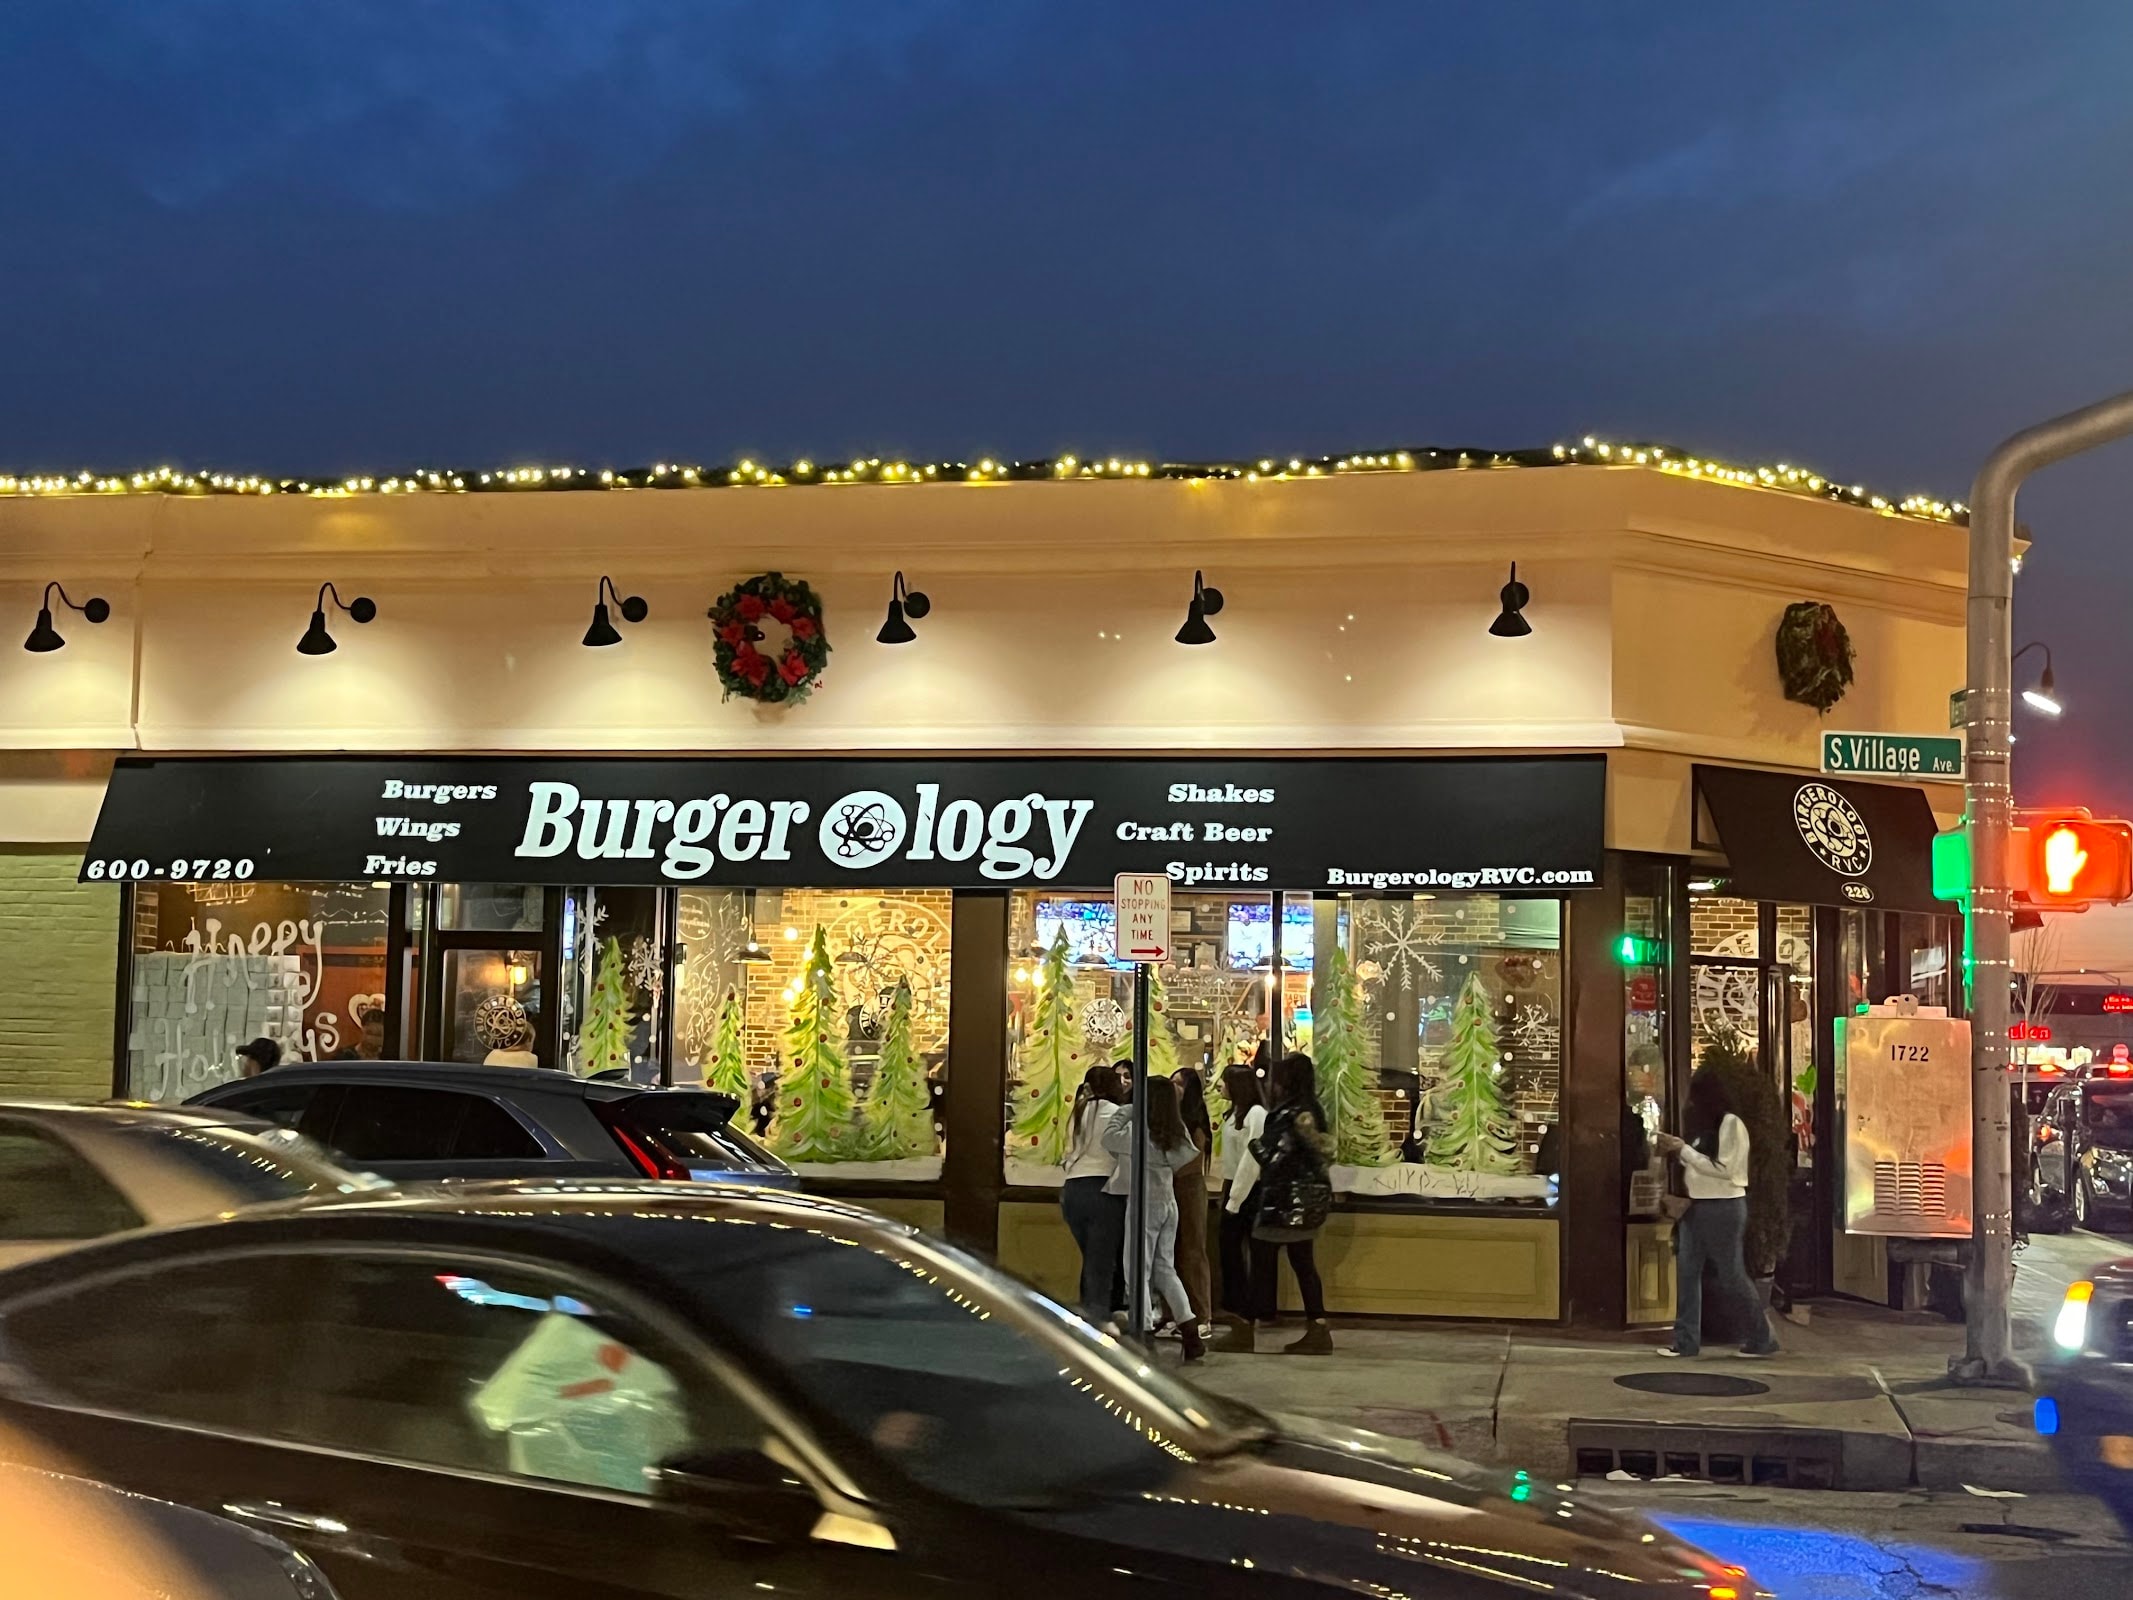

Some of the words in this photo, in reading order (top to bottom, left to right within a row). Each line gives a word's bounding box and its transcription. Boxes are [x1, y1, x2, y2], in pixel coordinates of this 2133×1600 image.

[382, 780, 498, 804] Burgers
[1168, 784, 1275, 803] Shakes
[1797, 787, 1869, 849] BURGEROLOGY
[376, 817, 461, 842] Wings
[1116, 821, 1195, 842] Craft
[1203, 822, 1273, 842] Beer
[86, 858, 255, 880] 600-9720
[363, 854, 437, 876] Fries
[1166, 861, 1269, 885] Spirits
[1832, 855, 1862, 872] RVC
[1134, 879, 1153, 896] NO
[1327, 867, 1594, 888] BurgerologyRVC.com
[1120, 898, 1166, 911] STOPPING
[1132, 913, 1153, 924] ANY
[1131, 929, 1153, 941] TIME
[1621, 936, 1661, 962] ATM
[1892, 1044, 1929, 1062] 1722
